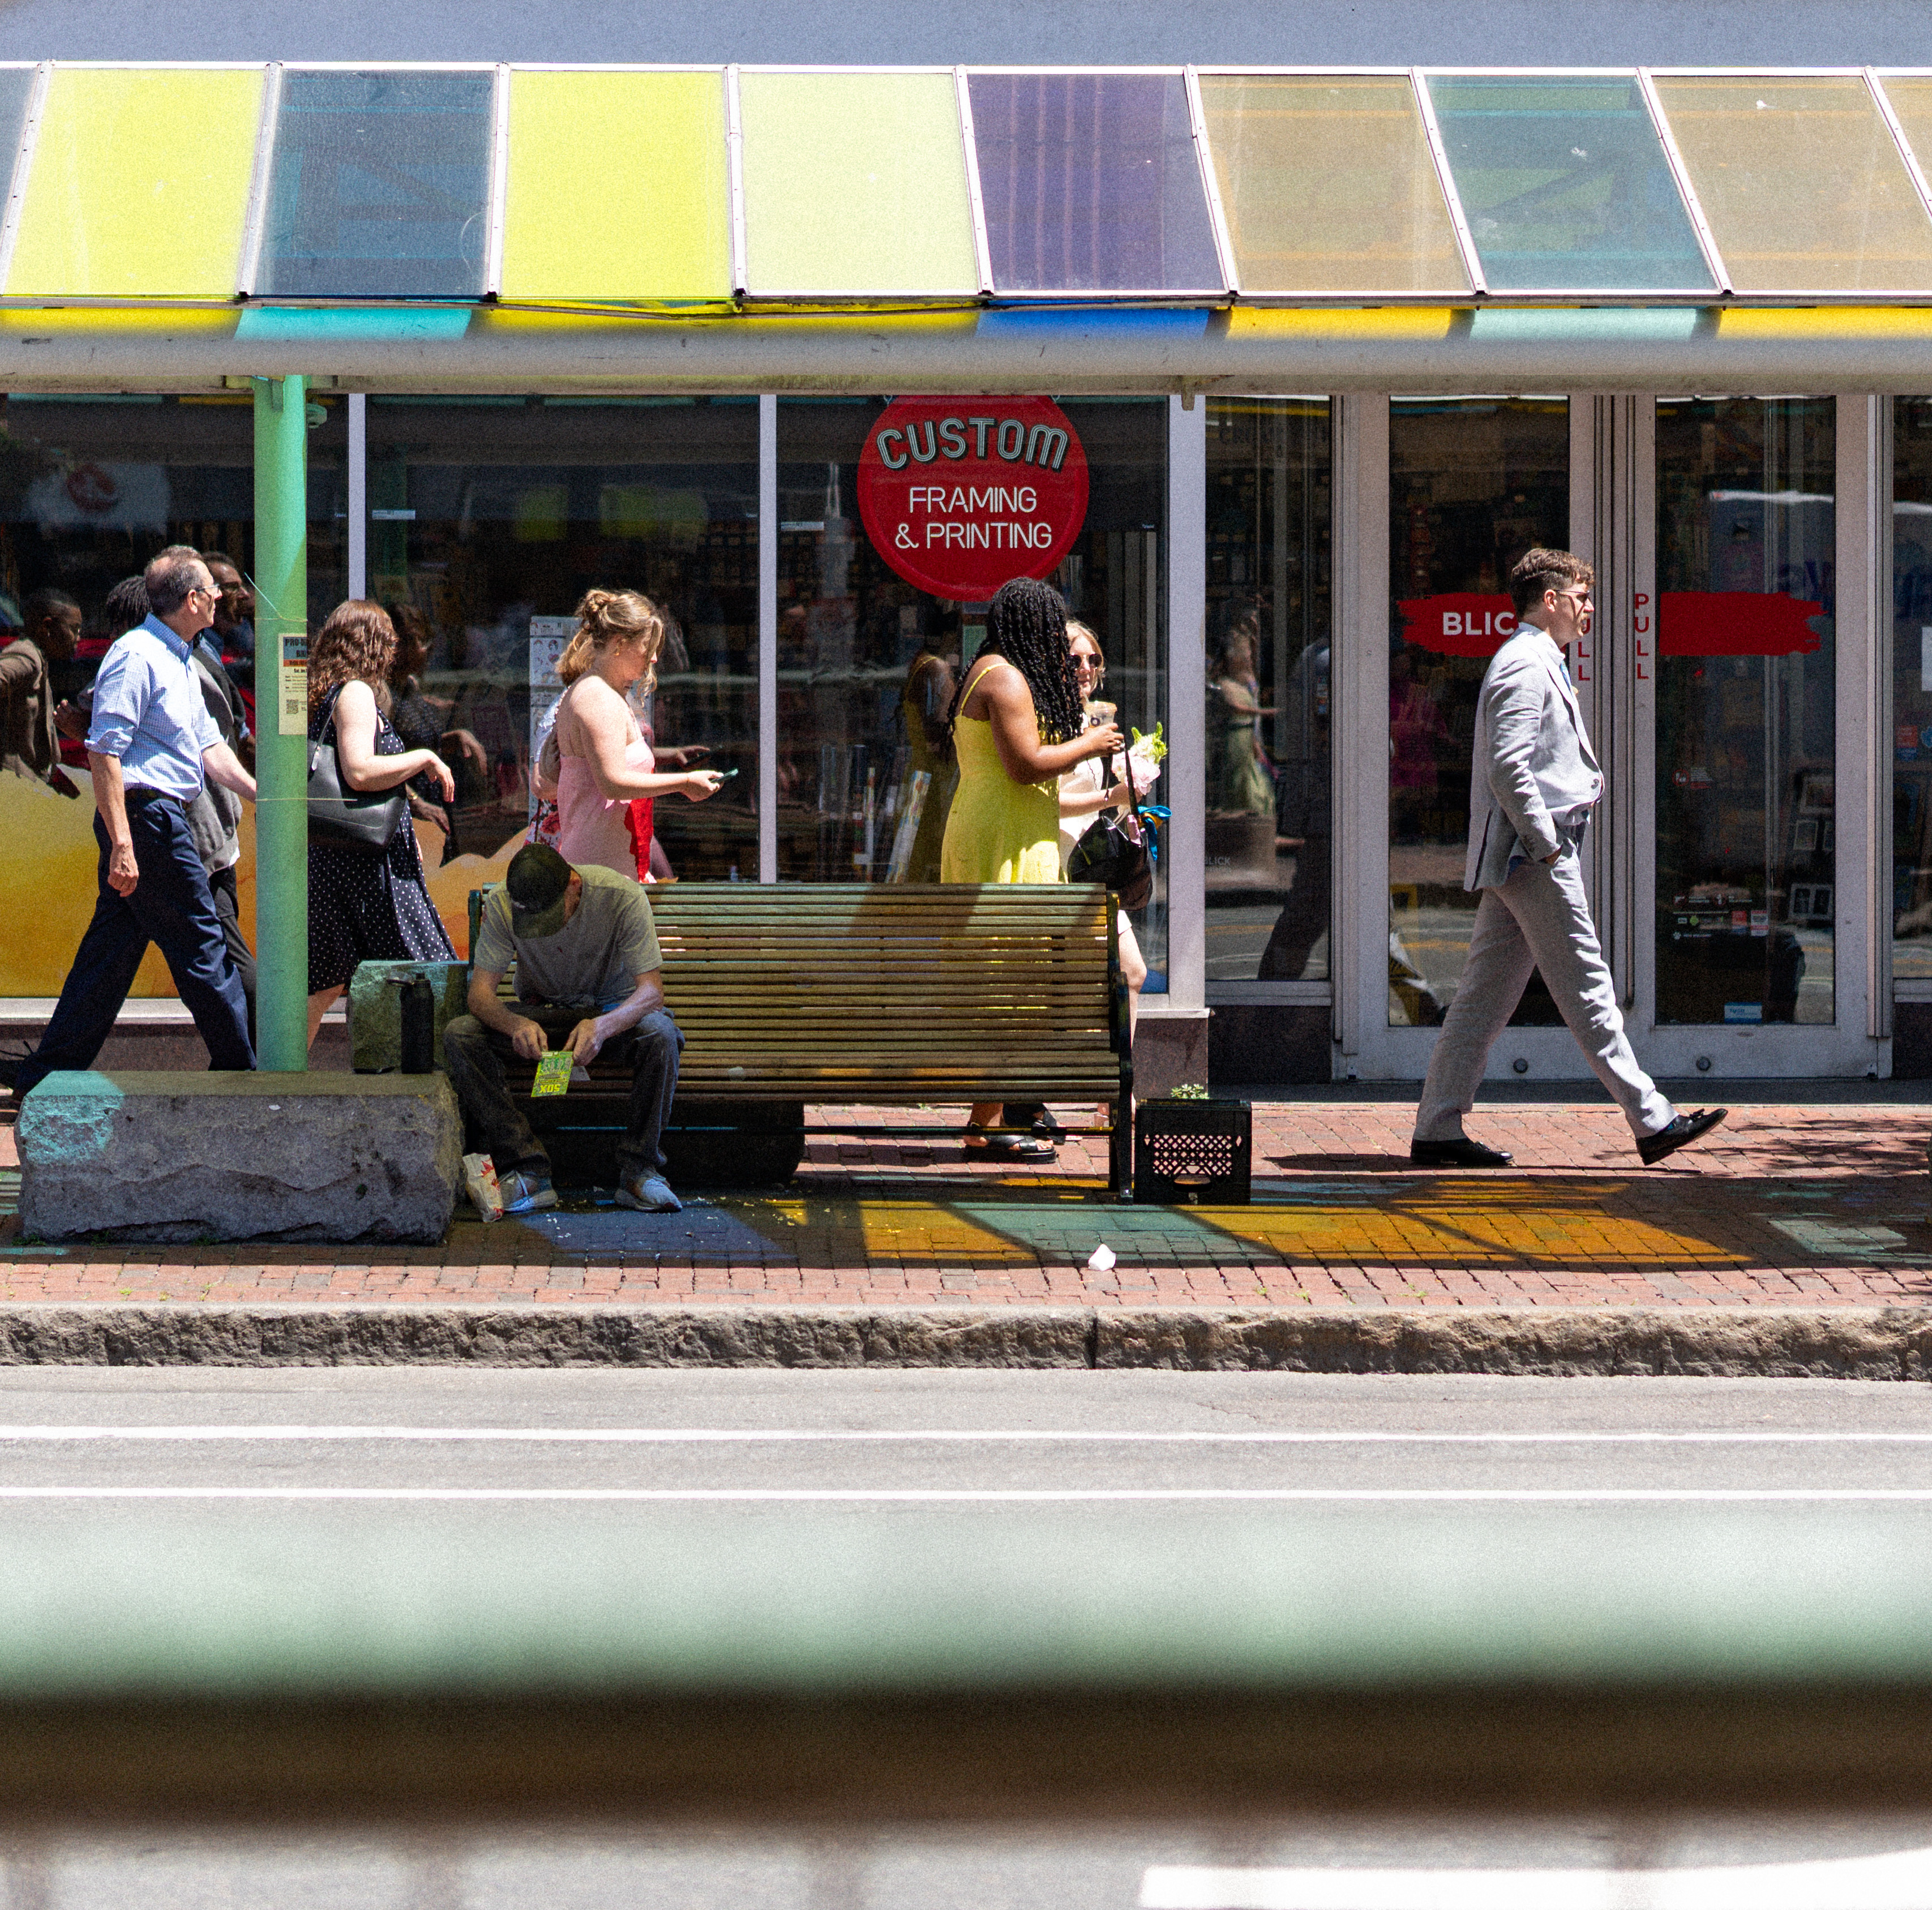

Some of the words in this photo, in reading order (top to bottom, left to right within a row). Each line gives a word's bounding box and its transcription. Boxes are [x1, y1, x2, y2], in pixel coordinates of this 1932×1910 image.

[877, 417, 1069, 471] CUSTOM
[909, 487, 1037, 513] FRAMING
[895, 523, 919, 549] &
[927, 522, 1052, 549] PRINTING
[1442, 611, 1515, 636] BLIC
[1634, 593, 1650, 680] PULL
